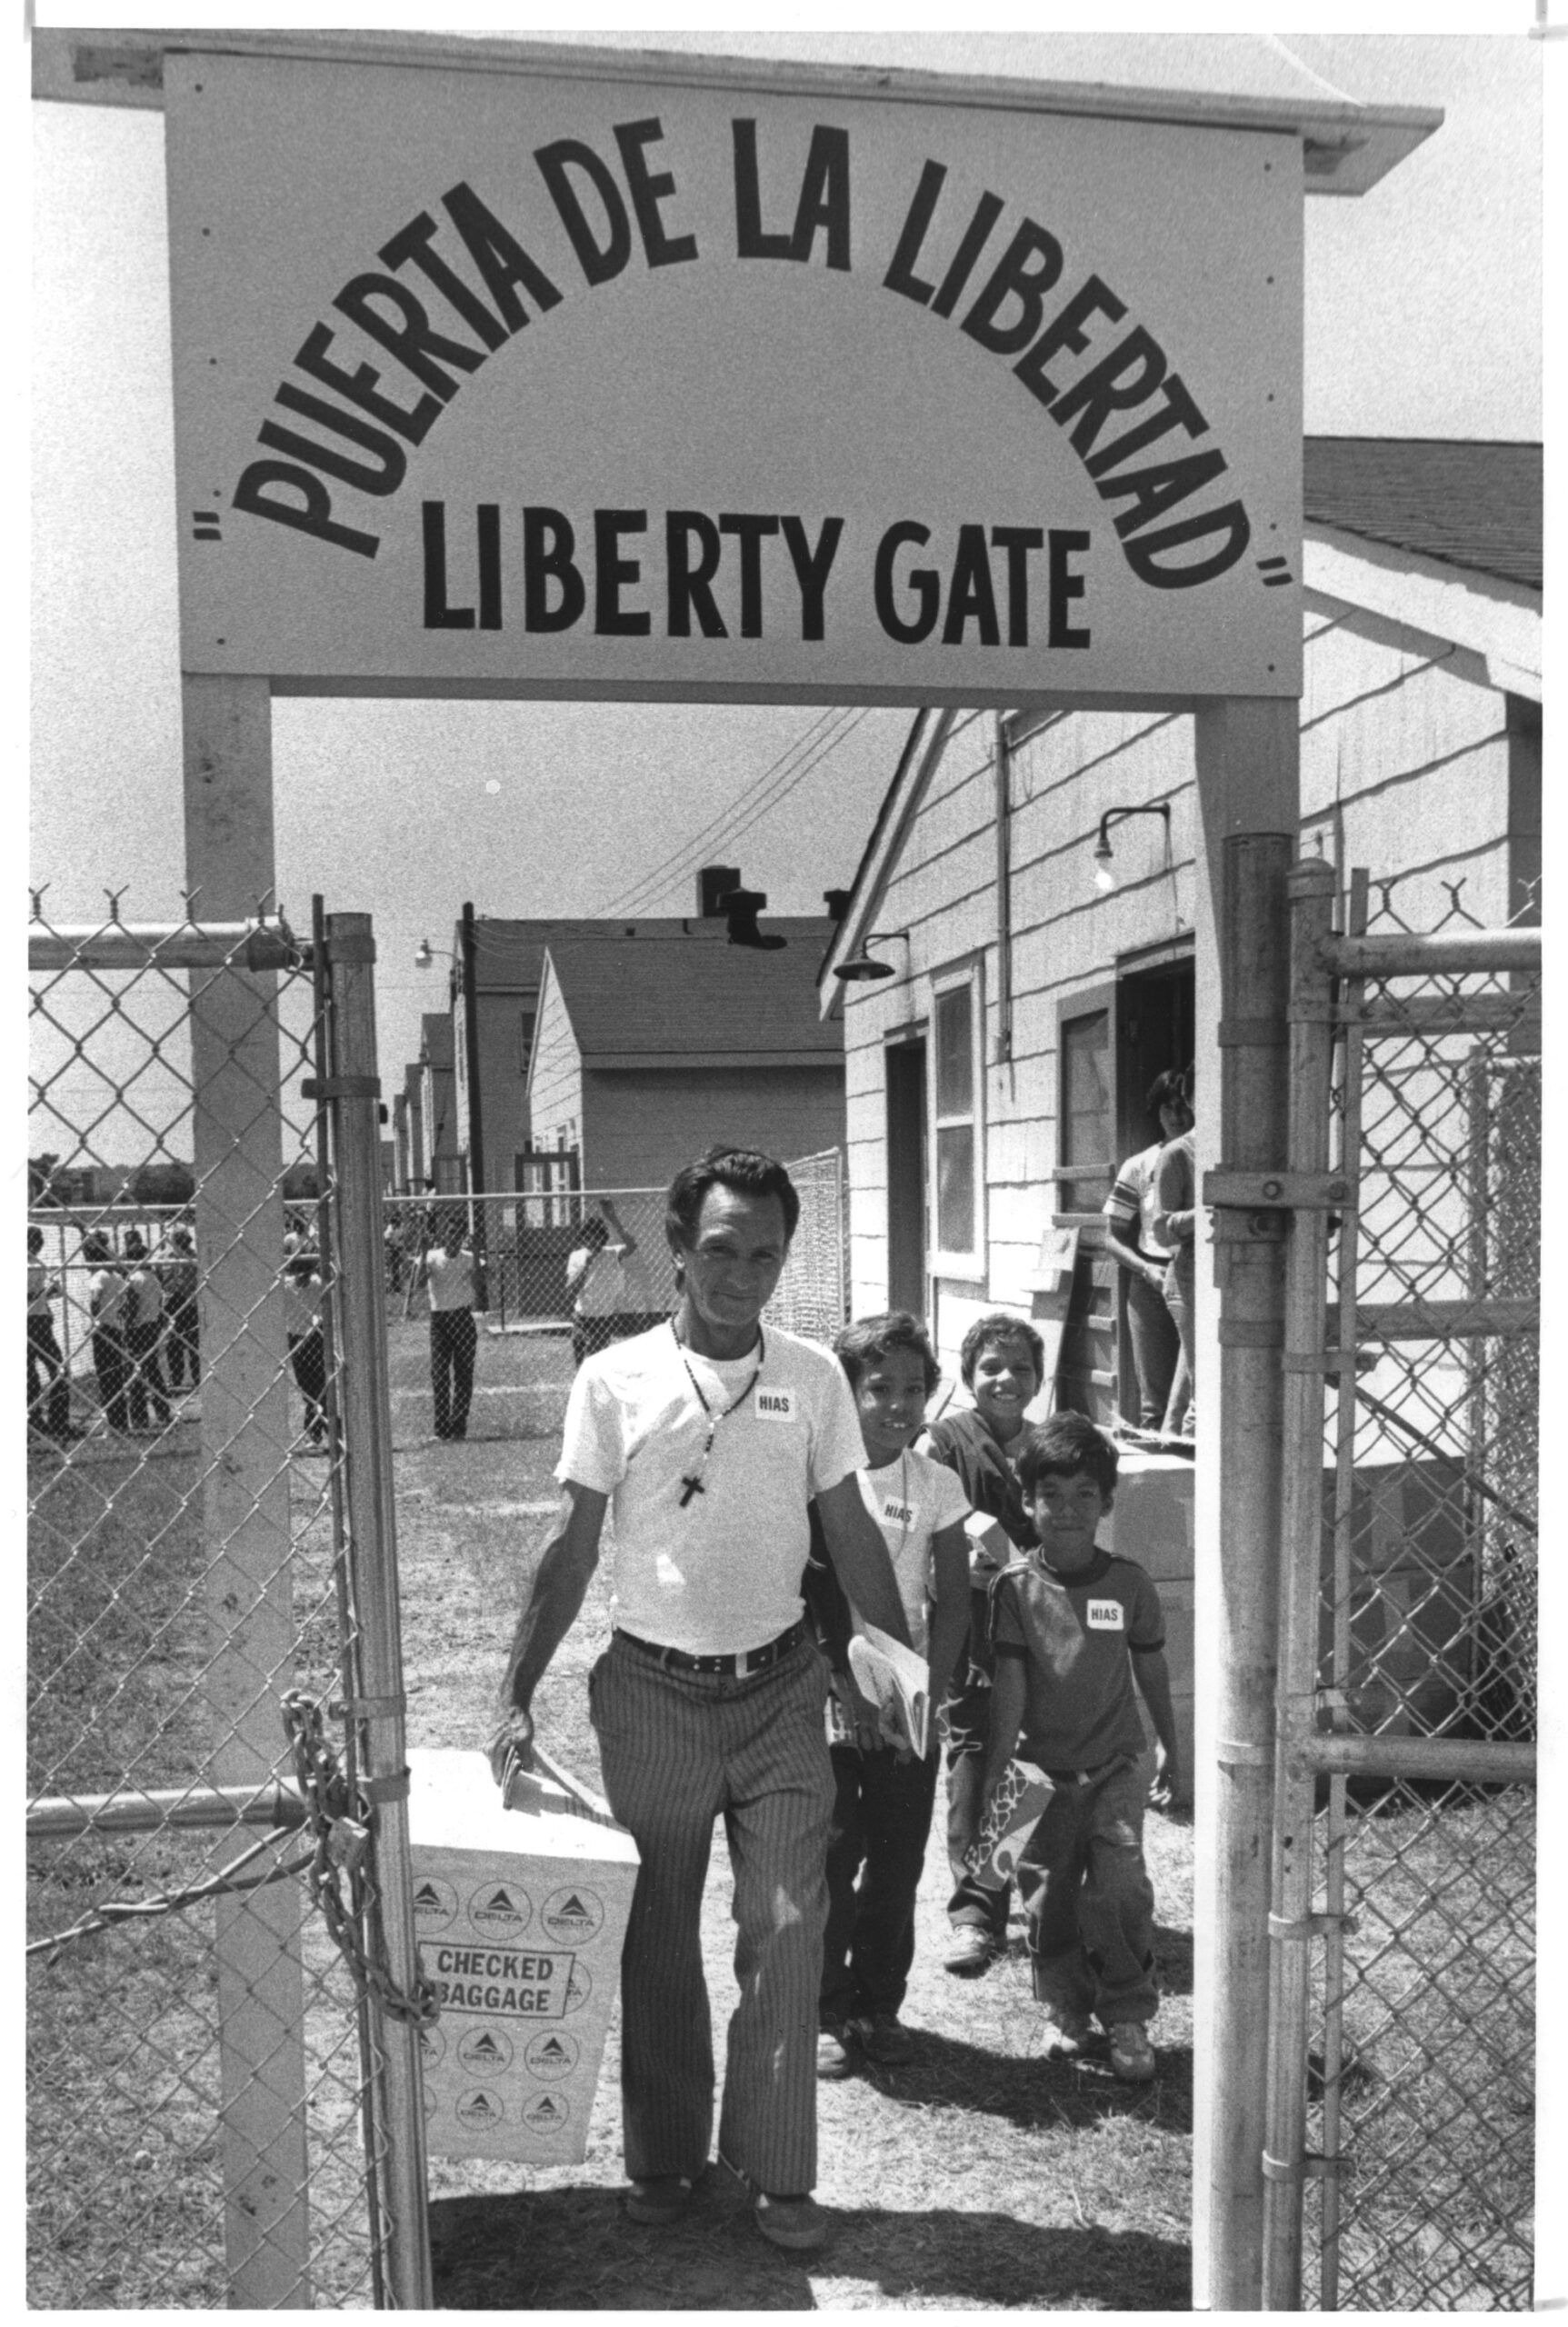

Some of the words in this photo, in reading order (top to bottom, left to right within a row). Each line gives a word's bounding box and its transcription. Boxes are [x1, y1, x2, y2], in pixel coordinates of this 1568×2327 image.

[533, 116, 699, 287] DE
[732, 117, 852, 272] LA
[421, 500, 844, 641] LIBERTY
[874, 520, 1091, 649] GATE
[758, 1394, 790, 1414] HIAS
[884, 1503, 913, 1523] HIAS
[1090, 1606, 1119, 1623] HIAS
[412, 1907, 450, 1916] ELTA
[474, 1911, 524, 1923] DELTA
[547, 1916, 595, 1927] DELTA
[436, 1949, 554, 1982] CHECKED
[463, 2052, 505, 2063] DELTA
[529, 2056, 572, 2065] DELTA
[460, 2109, 497, 2119] DELTA
